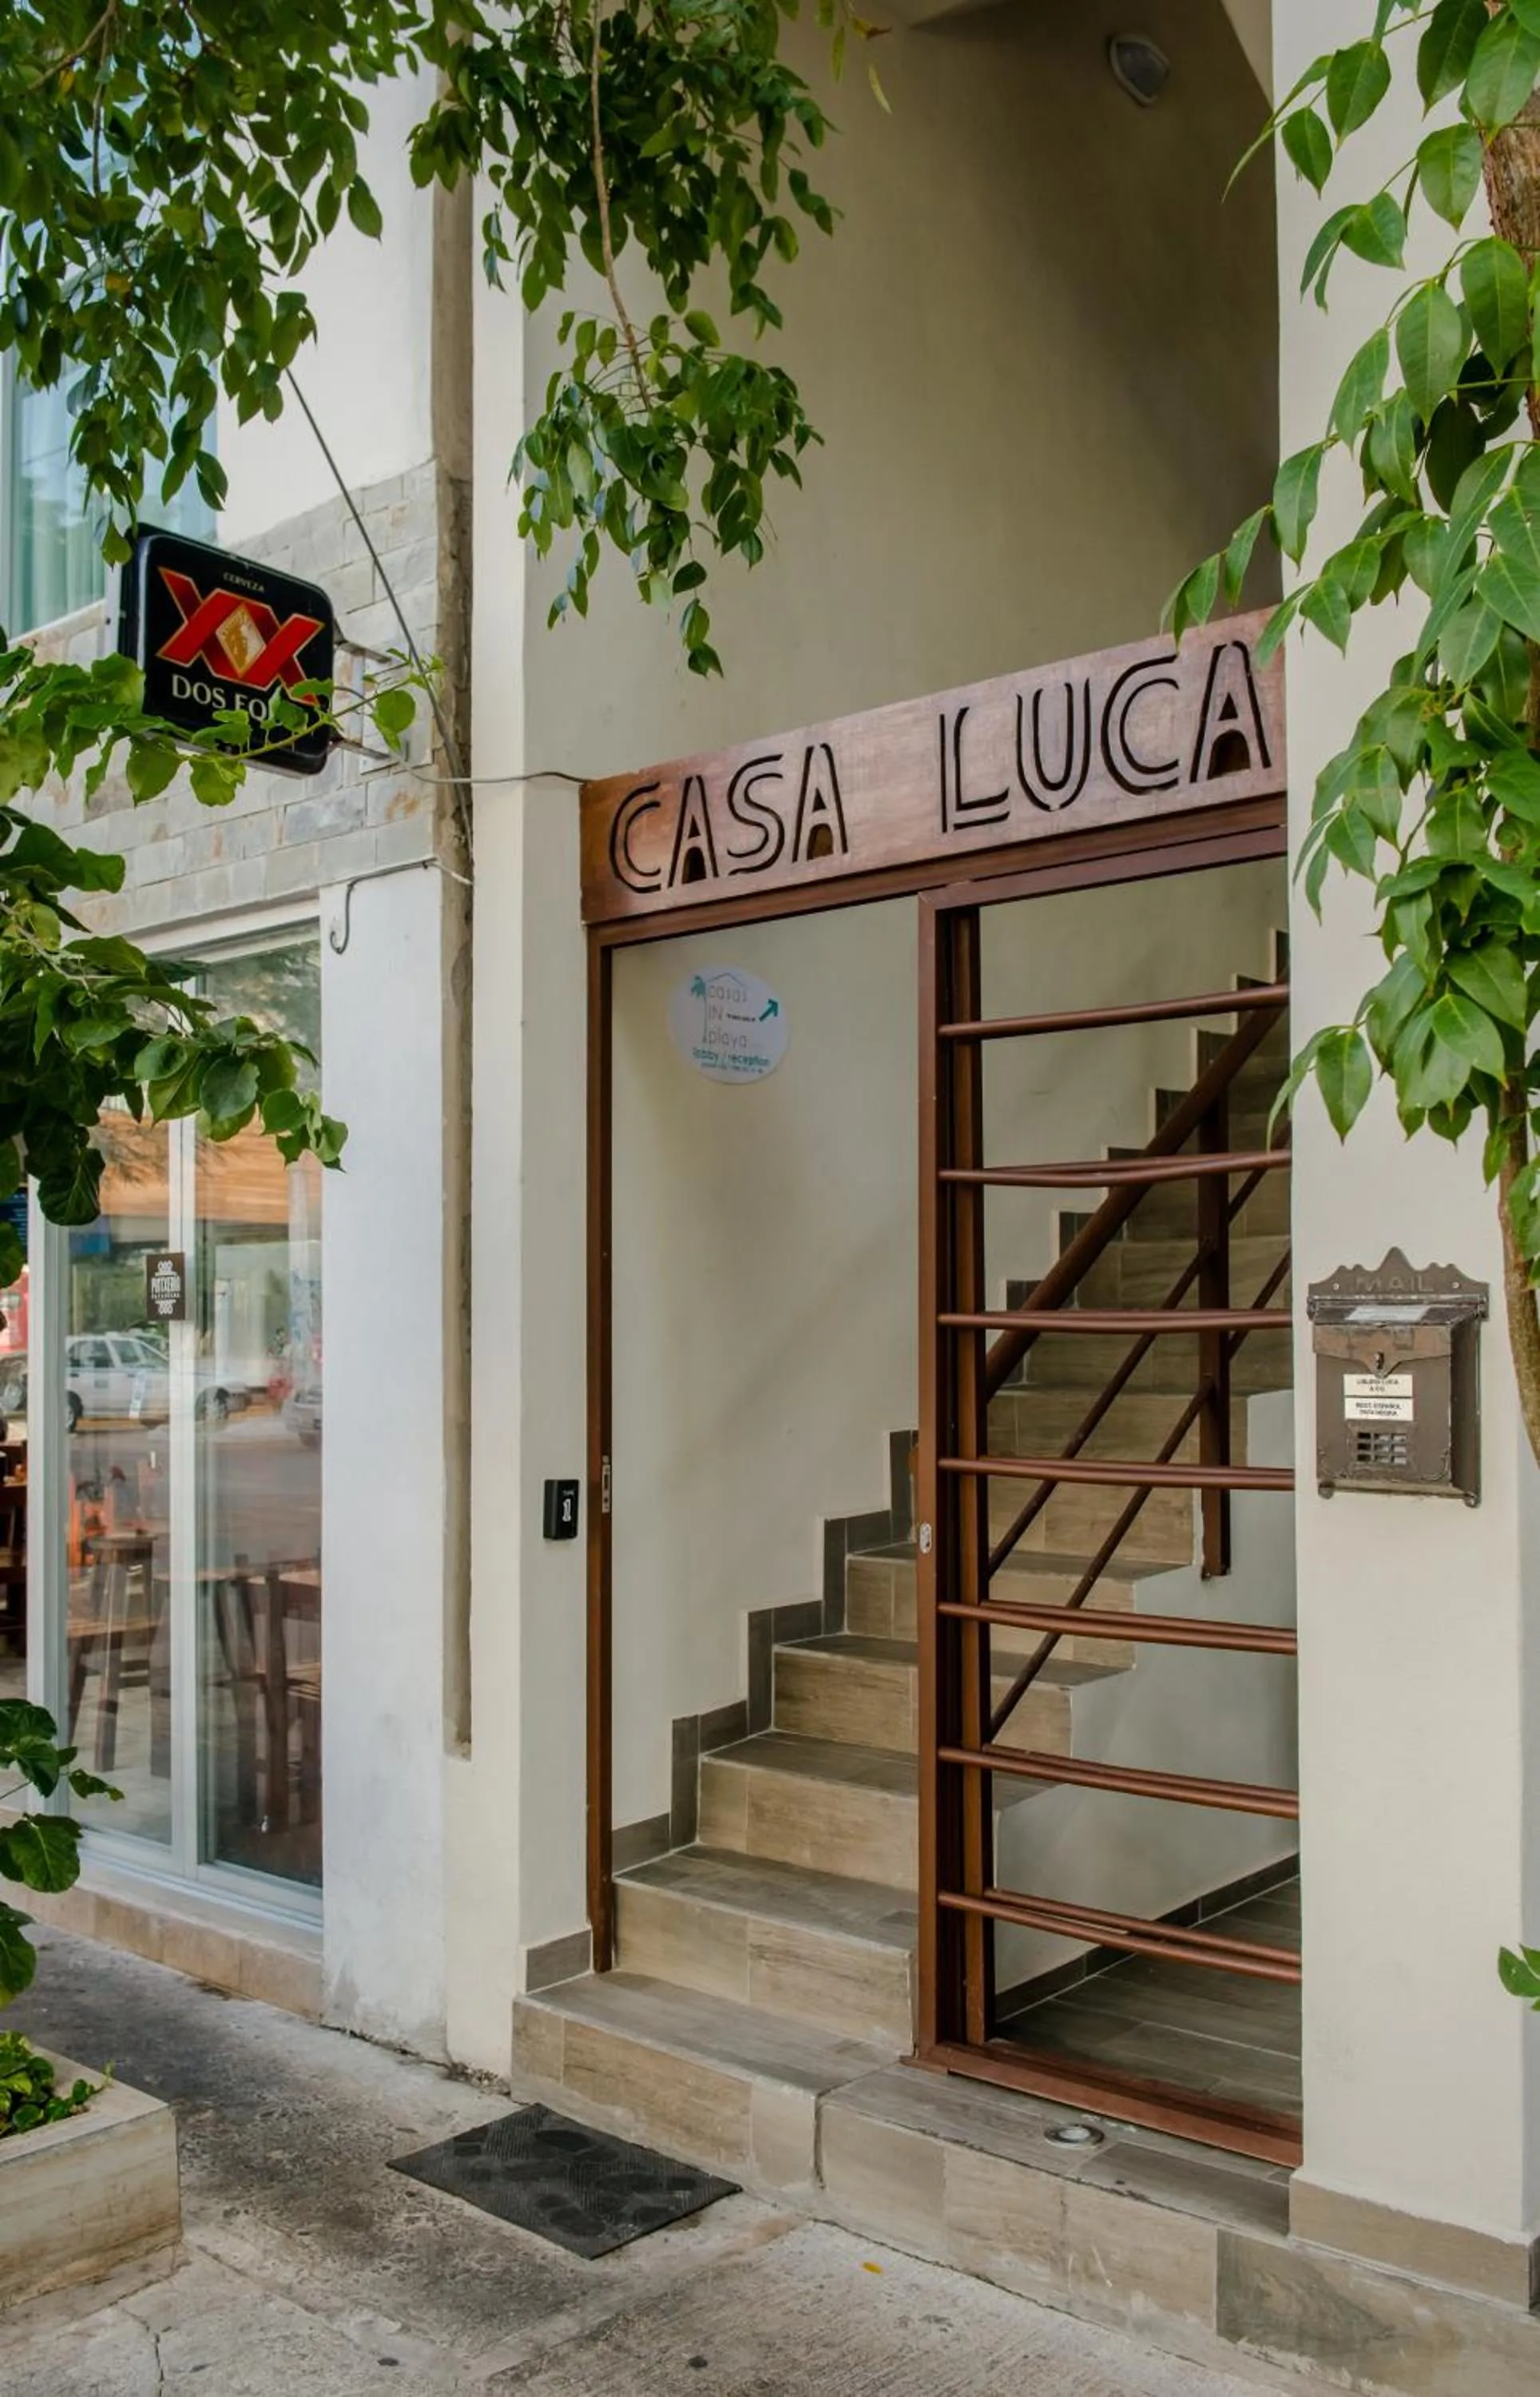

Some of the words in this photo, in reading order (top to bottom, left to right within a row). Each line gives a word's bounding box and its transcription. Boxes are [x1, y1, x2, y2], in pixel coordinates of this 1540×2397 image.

[223, 571, 265, 594] CERVEZA
[171, 674, 226, 710] DOS
[609, 742, 849, 893] CASA
[939, 640, 1272, 833] LUCA
[708, 1005, 724, 1022] IN
[708, 1028, 748, 1049] playa
[1355, 1275, 1435, 1292] MAIL
